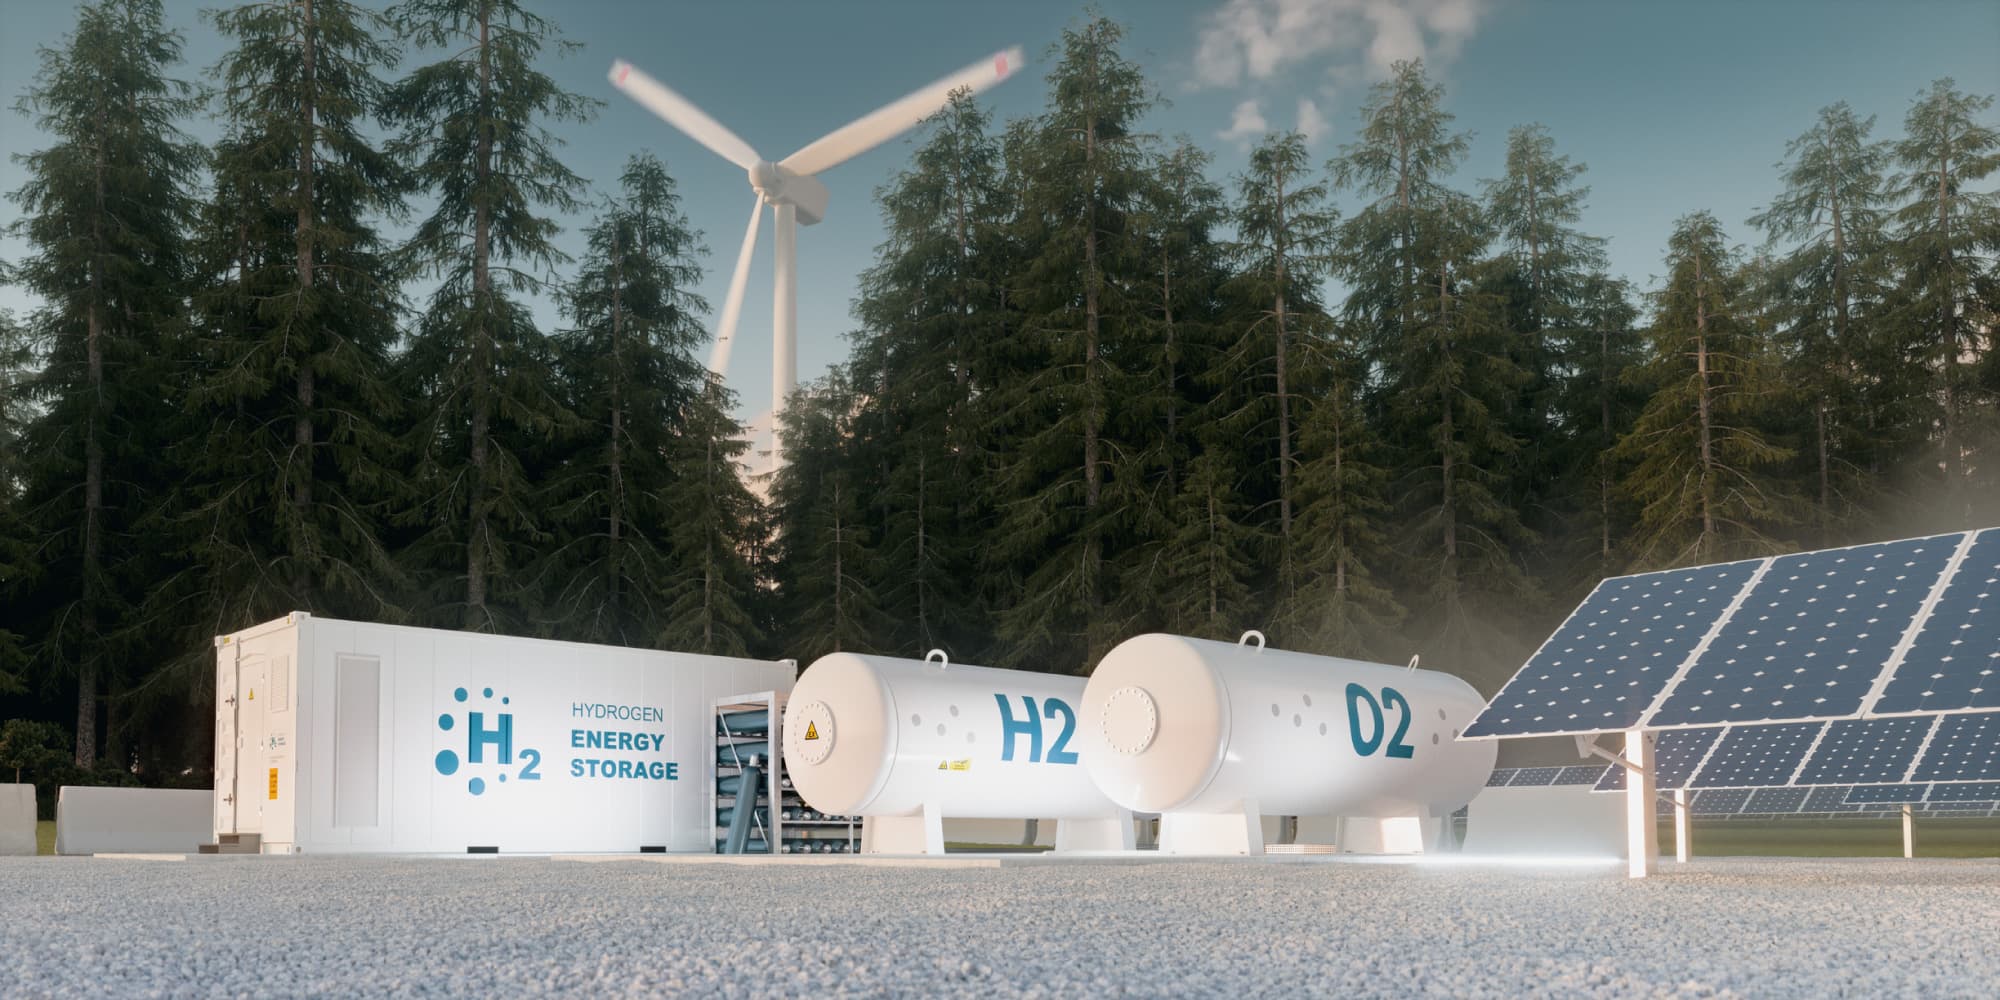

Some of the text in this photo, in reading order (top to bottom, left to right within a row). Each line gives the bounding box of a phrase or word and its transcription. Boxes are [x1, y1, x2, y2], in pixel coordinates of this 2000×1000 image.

[571, 702, 664, 723] HYDROGEN
[571, 729, 665, 752] ENERGY
[994, 693, 1079, 765] H2
[570, 758, 679, 781] STORAGE
